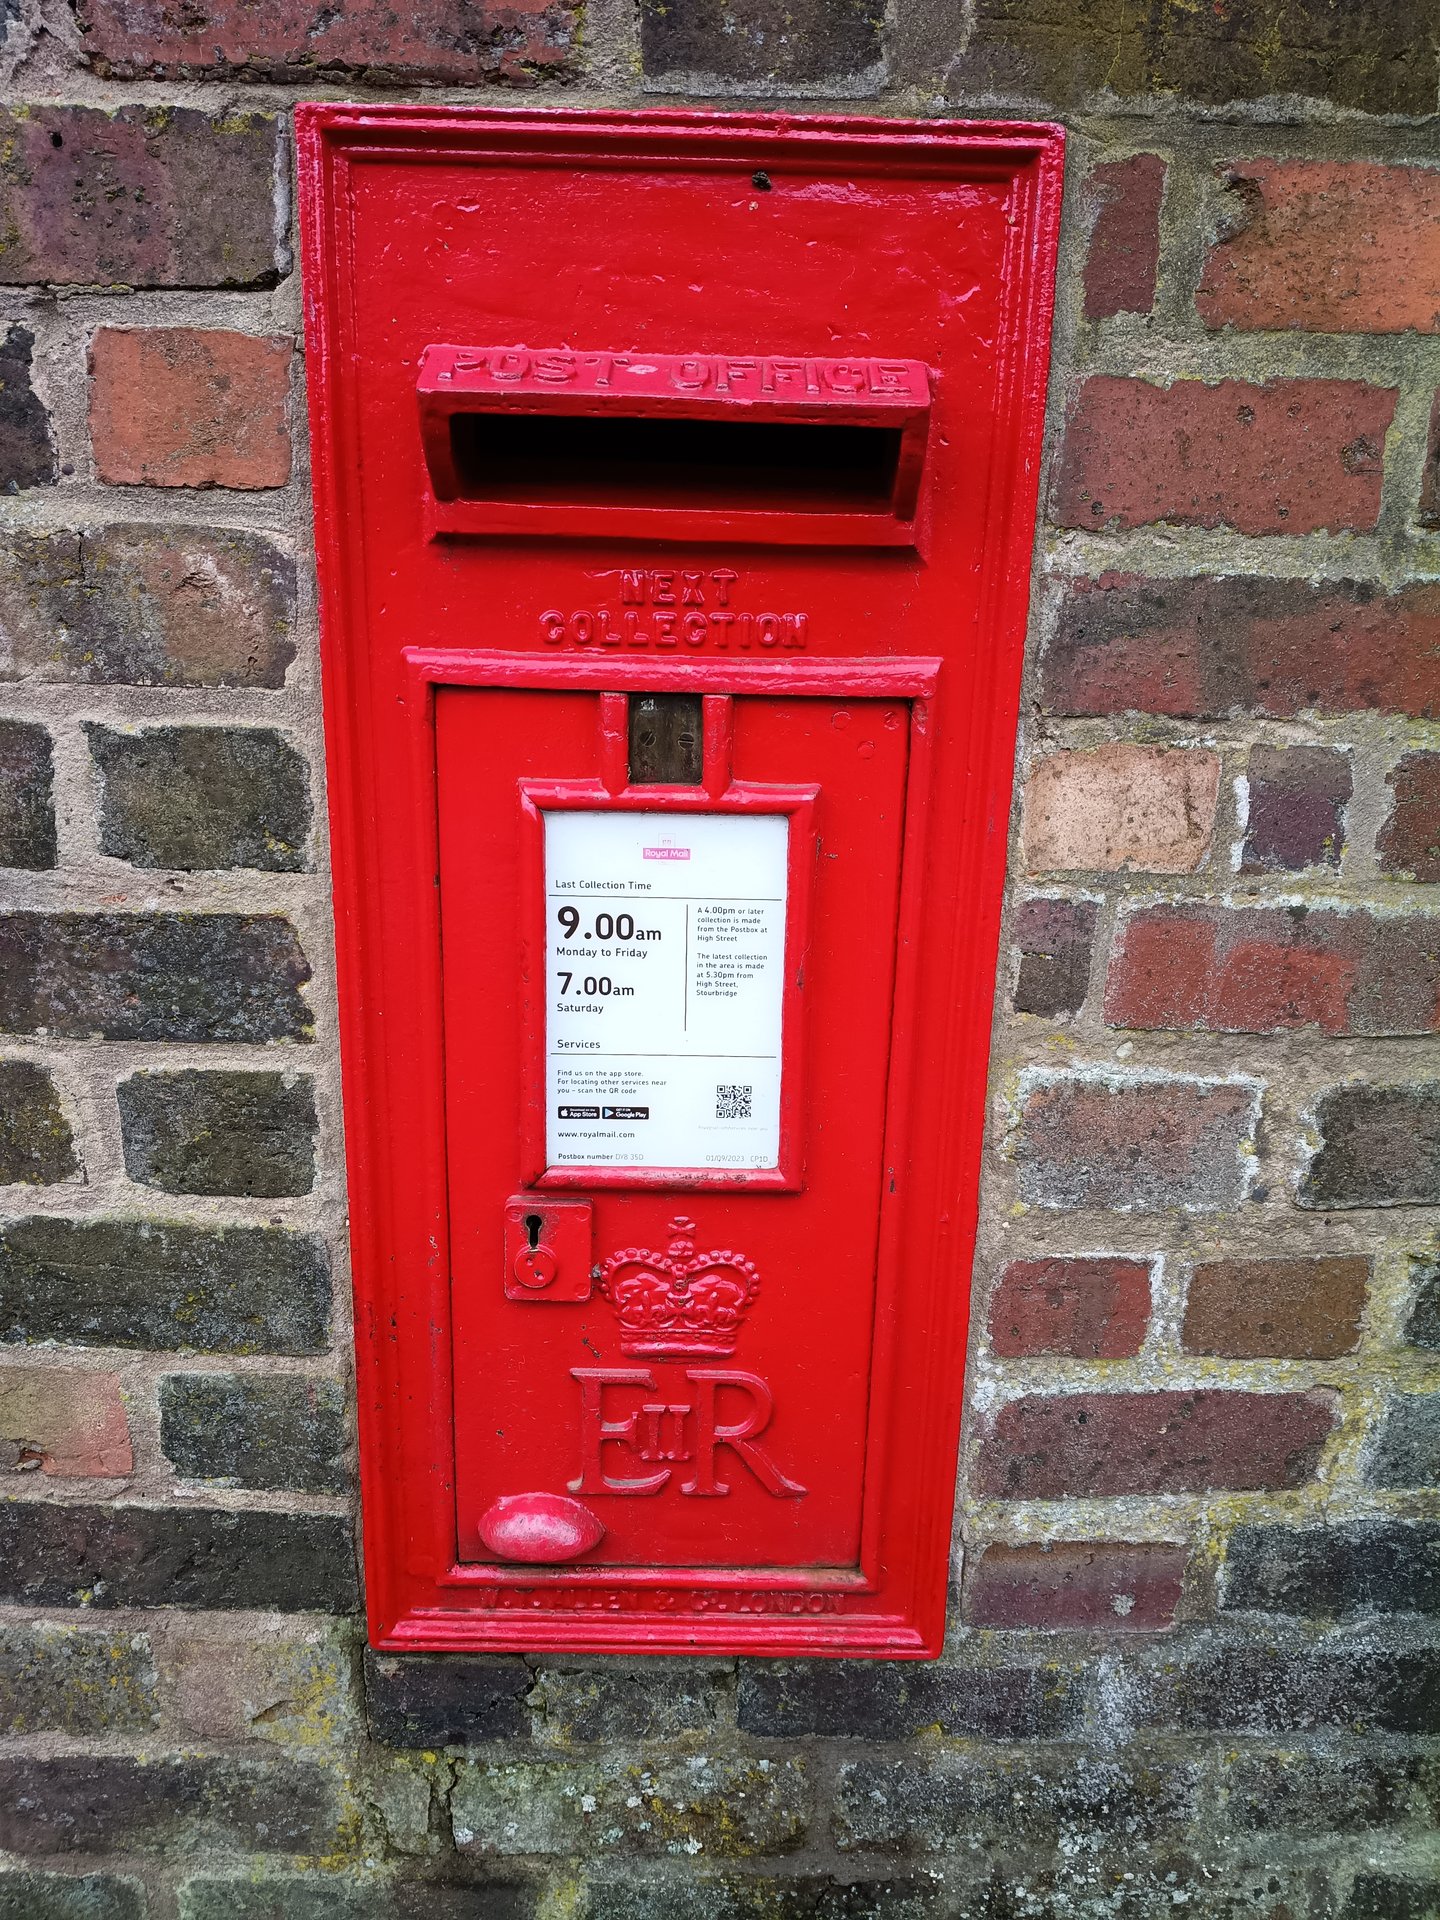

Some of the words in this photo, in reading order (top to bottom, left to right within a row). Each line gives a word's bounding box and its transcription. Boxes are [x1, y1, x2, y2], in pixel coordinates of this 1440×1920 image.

[438, 352, 630, 386] POST
[668, 361, 913, 395] OFFICE
[621, 568, 739, 606] NEXT
[539, 609, 810, 648] COLLECTION
[645, 849, 668, 859] Royal
[670, 849, 689, 858] Mail
[556, 880, 575, 888] Last
[580, 880, 625, 889] Collection
[628, 881, 651, 889] Time
[705, 907, 735, 915] 4.00pm
[558, 906, 661, 940] 9.00am
[557, 947, 597, 958] Monday
[616, 948, 647, 959] Friday
[706, 971, 734, 979] 5.30pm
[557, 972, 634, 995] 7.00am
[557, 1003, 603, 1014] Saturday
[558, 1039, 600, 1048] Services
[734, 1591, 846, 1615] LONDON
